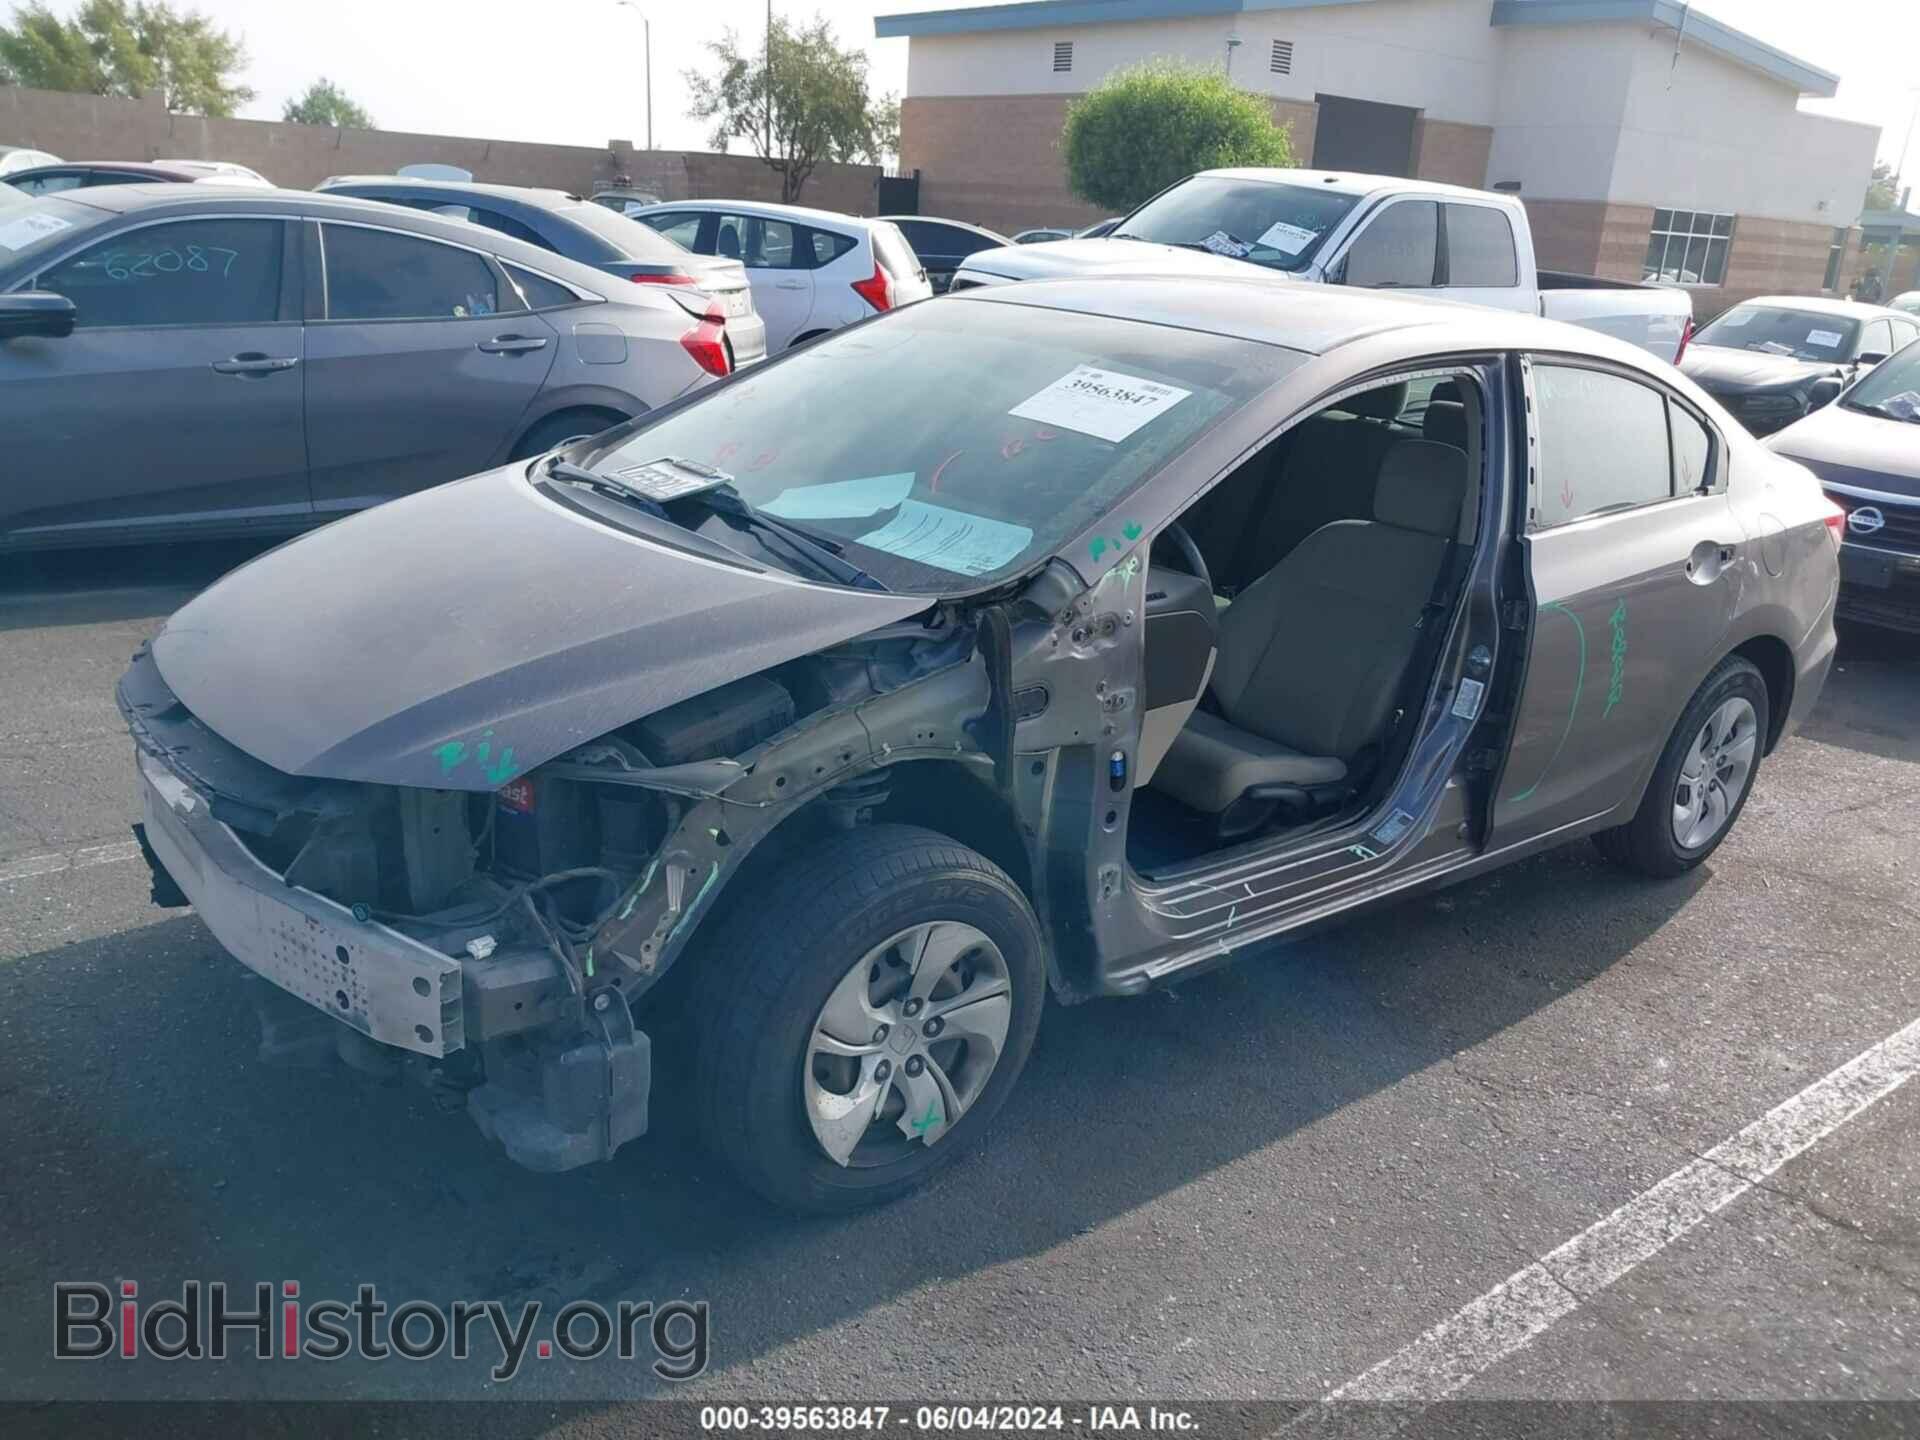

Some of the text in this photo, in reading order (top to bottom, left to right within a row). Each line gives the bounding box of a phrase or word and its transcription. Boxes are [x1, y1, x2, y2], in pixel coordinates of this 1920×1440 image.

[104, 245, 240, 280] 62087
[1065, 378, 1160, 408] 39563847
[499, 783, 528, 806] ast
